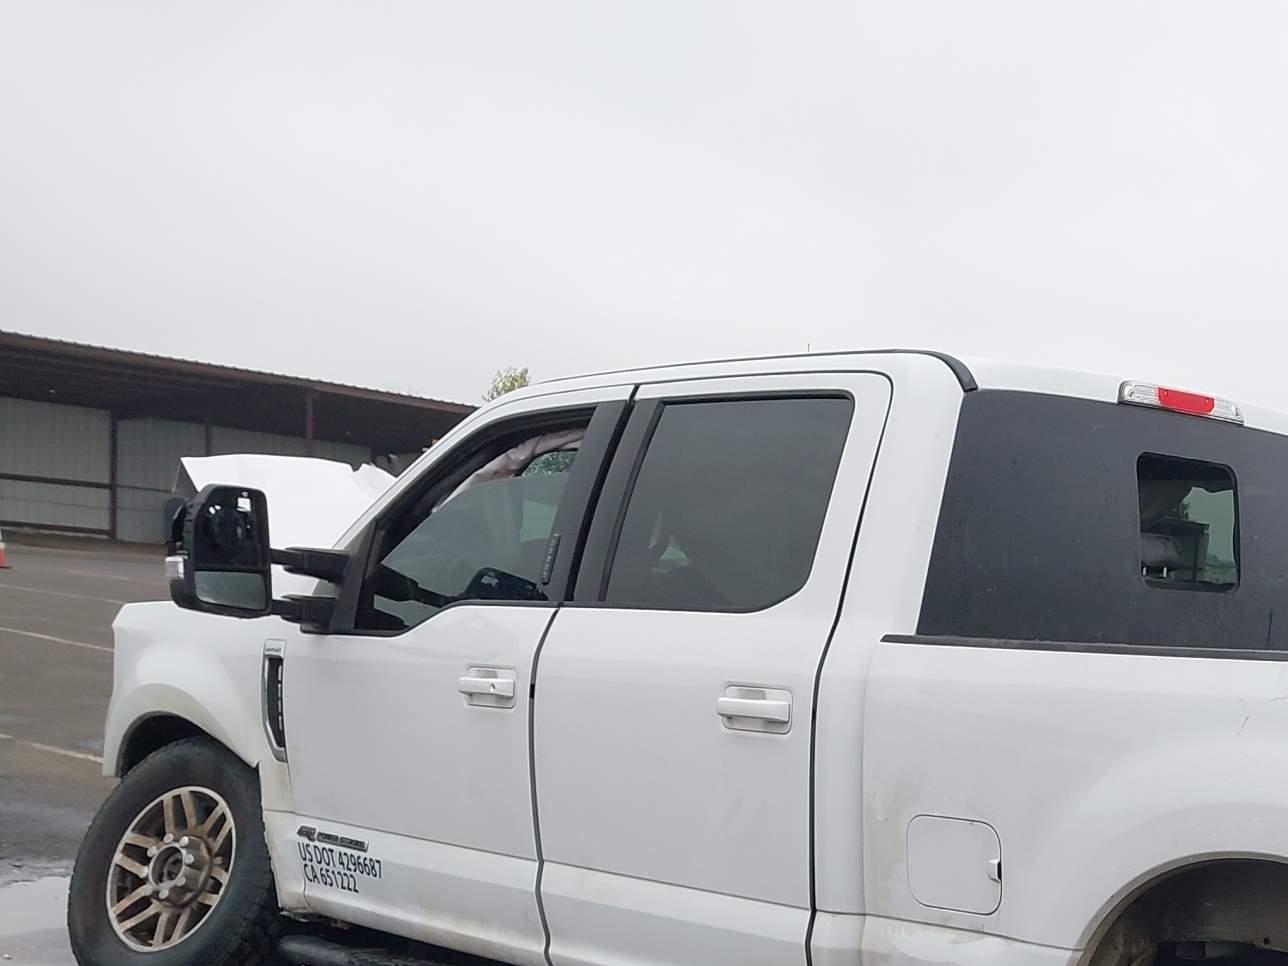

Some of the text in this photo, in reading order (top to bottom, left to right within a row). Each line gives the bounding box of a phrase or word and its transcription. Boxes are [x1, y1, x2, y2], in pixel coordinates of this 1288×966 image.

[303, 863, 359, 893] CA 651222
[338, 851, 382, 879] 4296687
